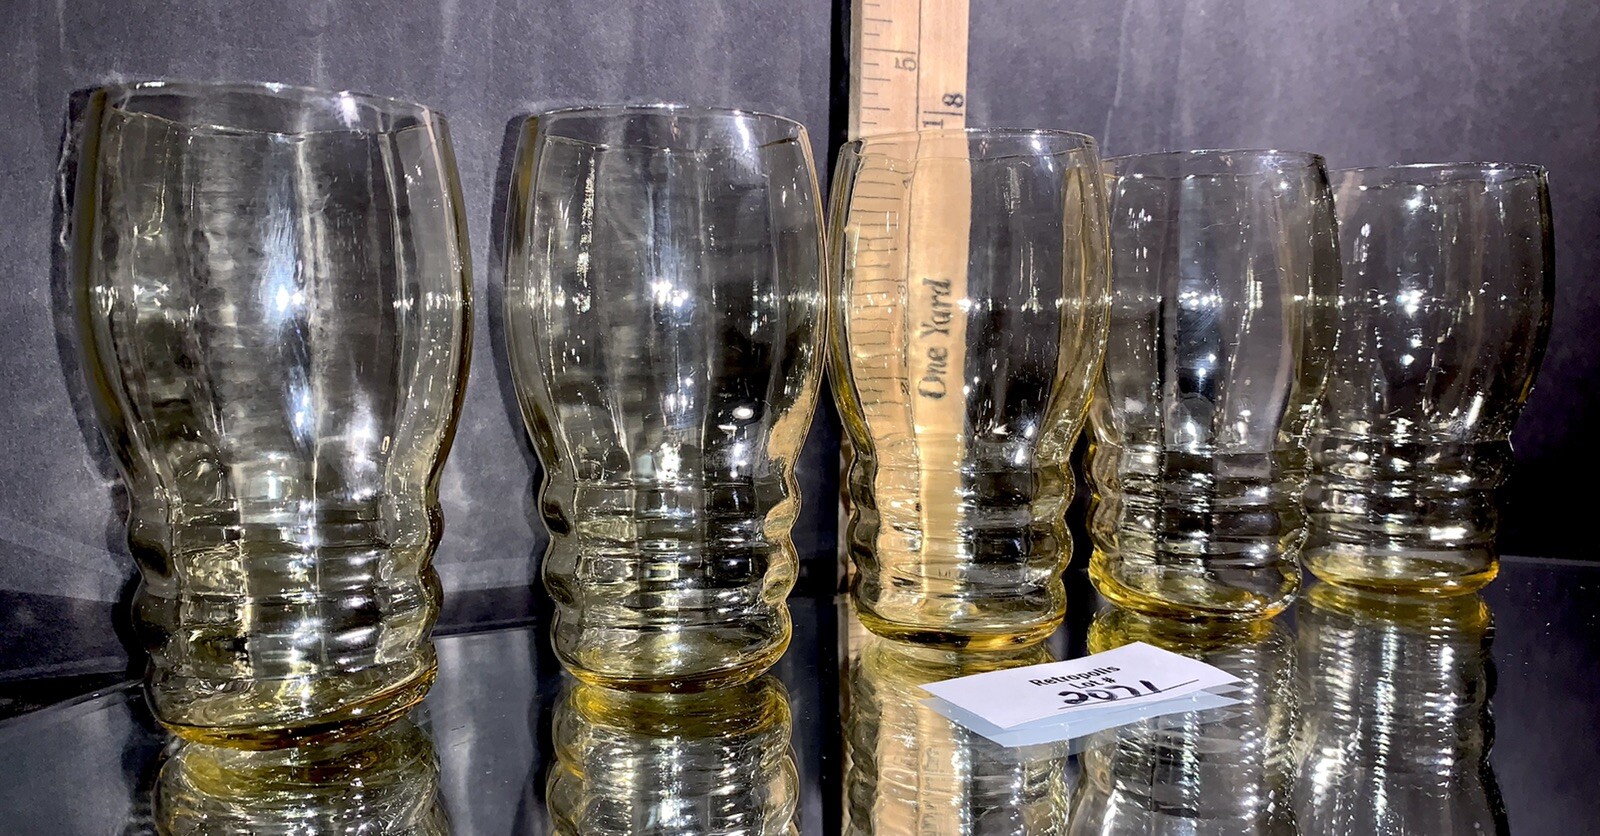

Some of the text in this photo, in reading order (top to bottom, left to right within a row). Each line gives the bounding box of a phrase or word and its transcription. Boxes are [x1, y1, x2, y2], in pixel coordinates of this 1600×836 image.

[894, 57, 917, 72] 5
[917, 278, 953, 401] One Yard
[1028, 666, 1121, 687] Retropolis
[1068, 680, 1105, 690] Lot
[1057, 679, 1162, 705] 2071
